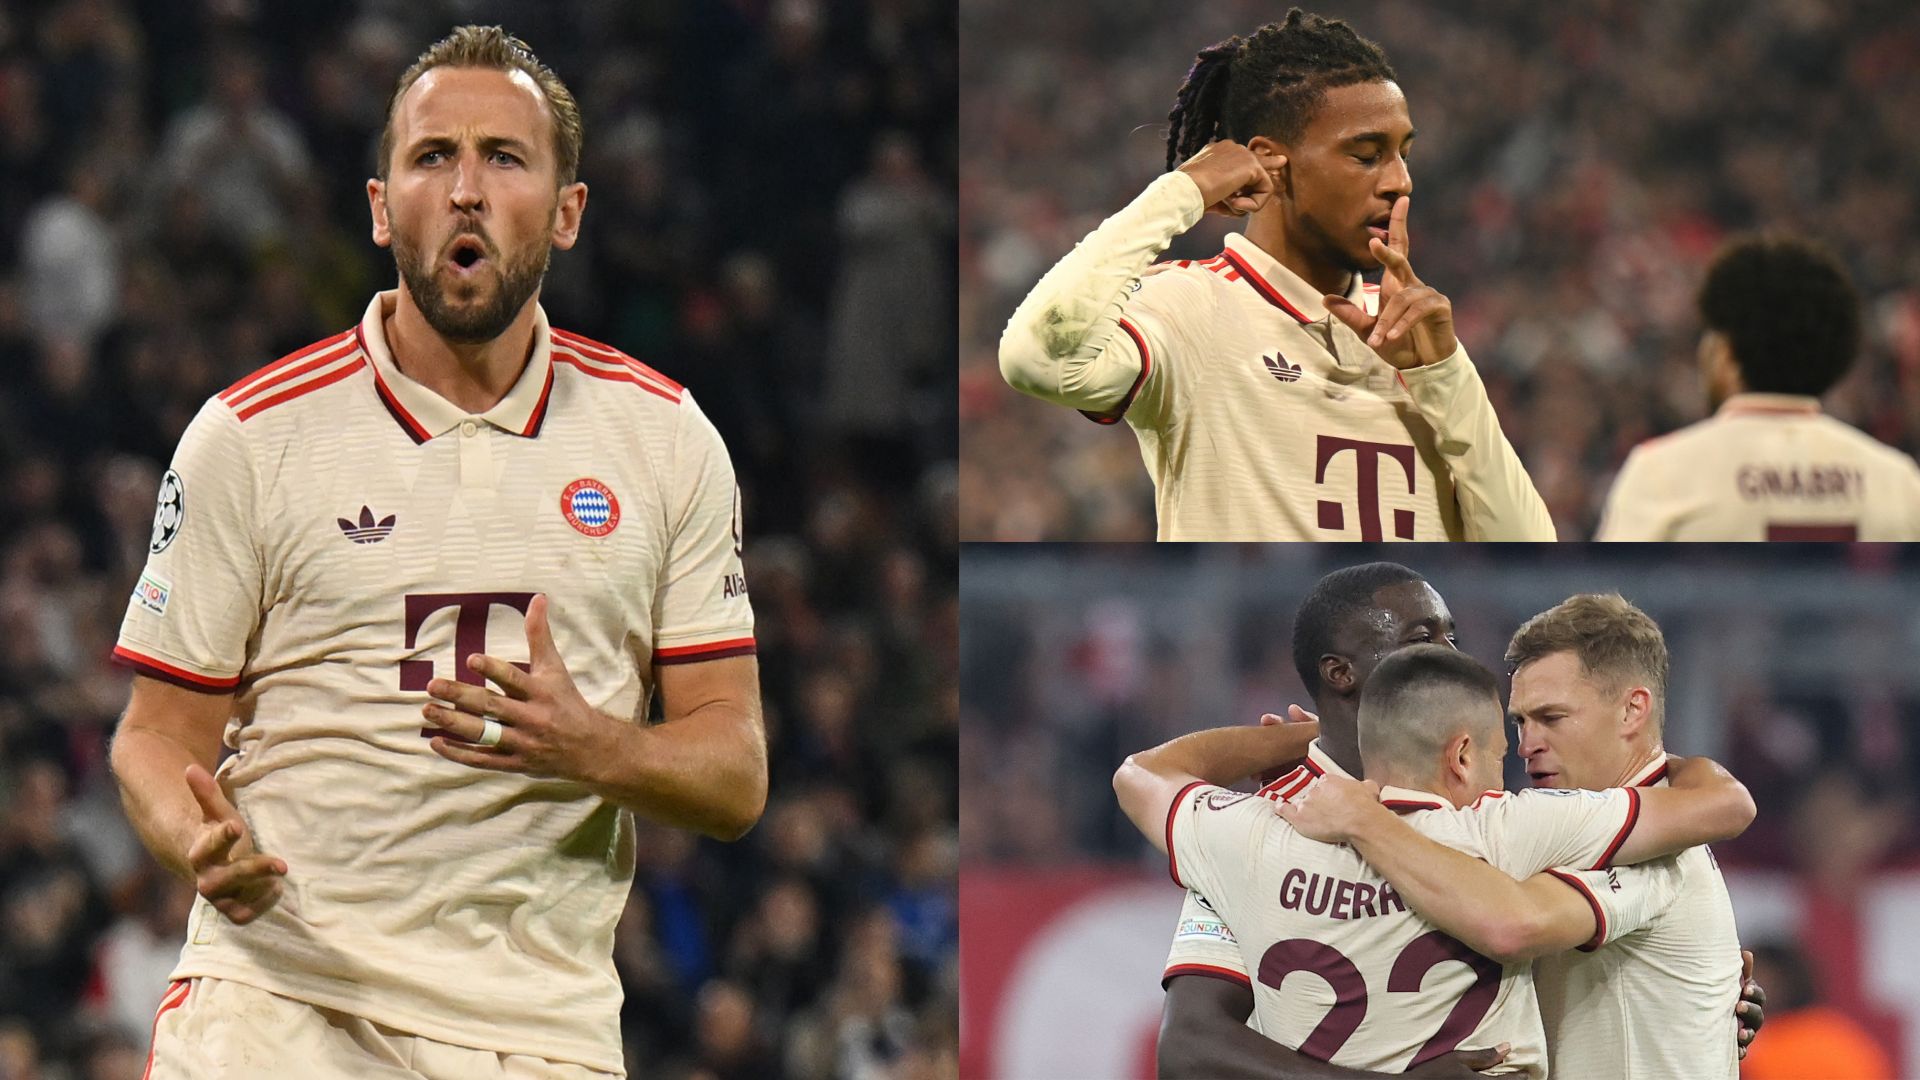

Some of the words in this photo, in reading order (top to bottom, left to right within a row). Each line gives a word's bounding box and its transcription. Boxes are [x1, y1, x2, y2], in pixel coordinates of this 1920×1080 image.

[579, 480, 614, 501] BAYERN
[1736, 464, 1865, 500] GNABRY
[1279, 868, 1406, 920] GUERR
[1257, 930, 1503, 1072] 22
